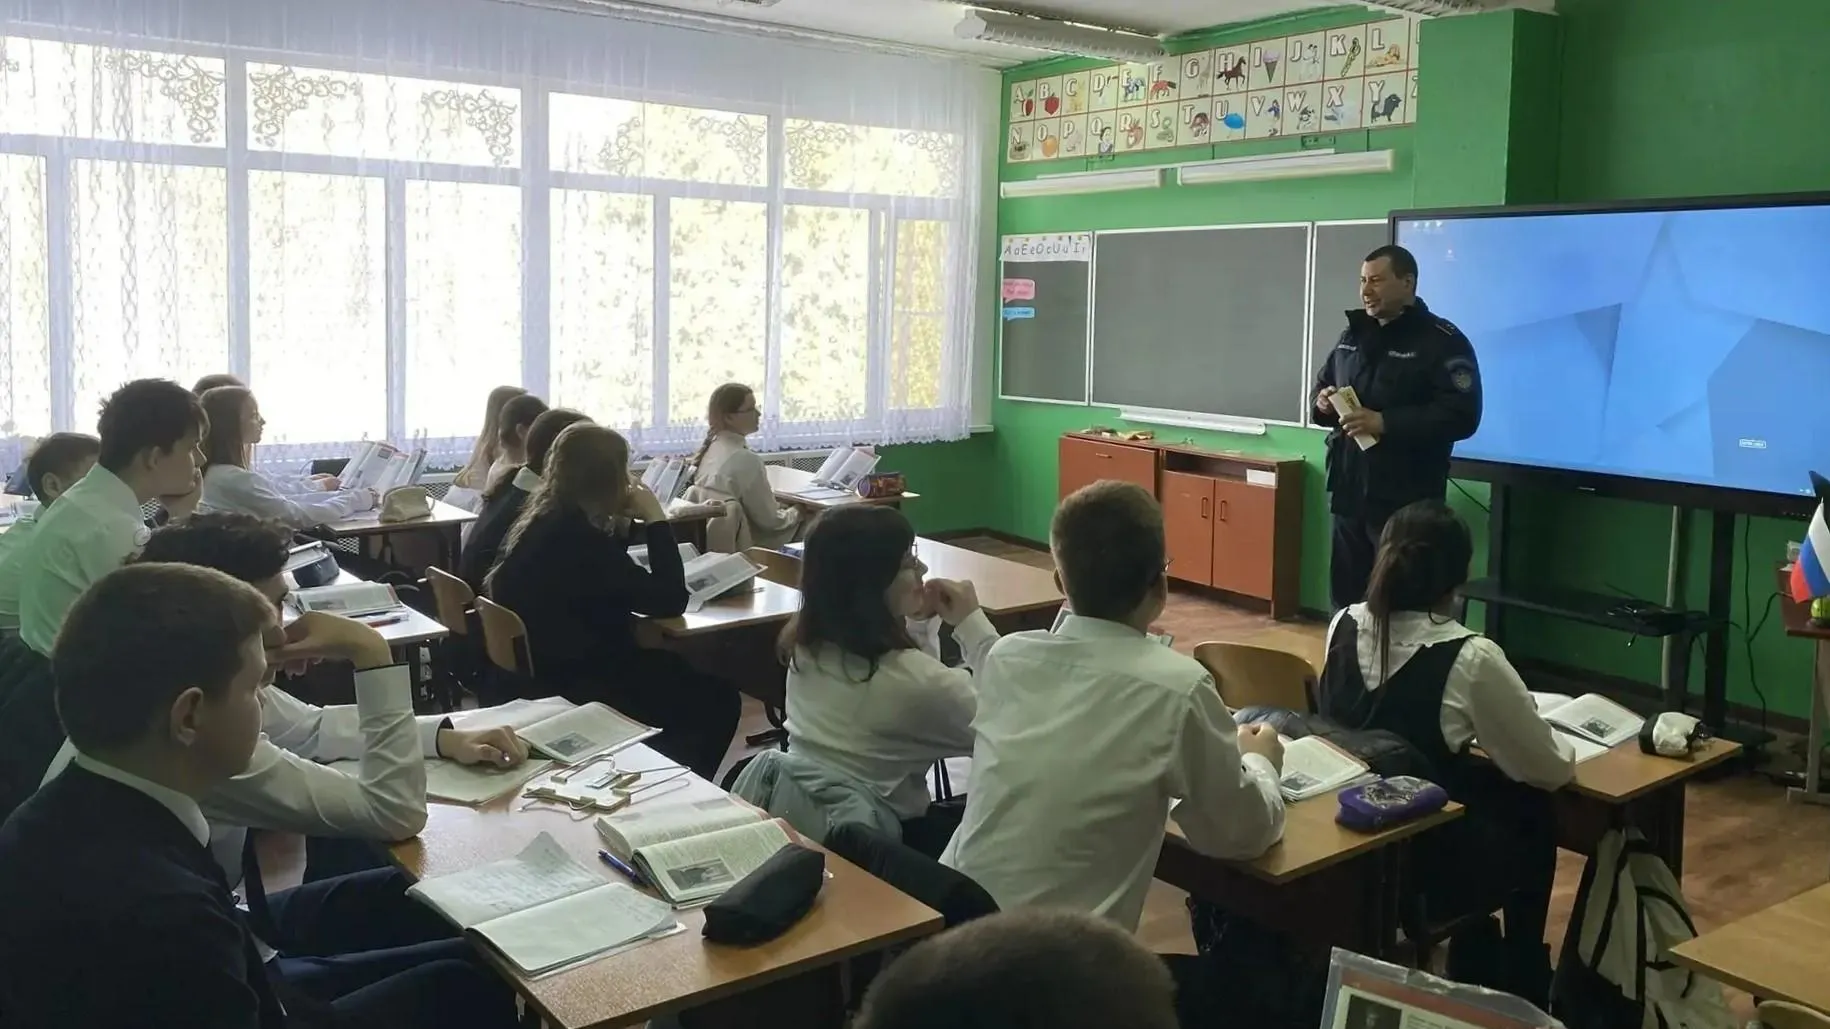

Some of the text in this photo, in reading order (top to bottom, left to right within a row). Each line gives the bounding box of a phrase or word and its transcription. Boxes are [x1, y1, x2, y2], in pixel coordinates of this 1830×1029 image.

[1330, 34, 1347, 57] K
[1371, 28, 1385, 51] L
[1254, 47, 1262, 68] I
[1290, 40, 1303, 62] J
[1152, 64, 1163, 83] F
[1185, 58, 1199, 79] G
[1040, 82, 1050, 101] B
[1065, 78, 1077, 97] C
[1093, 74, 1105, 93] D
[1368, 80, 1385, 104] Y
[1251, 96, 1265, 116] V
[1286, 90, 1307, 112] W
[1326, 85, 1344, 108] X
[1150, 108, 1161, 129] S
[1182, 104, 1195, 125] T
[1215, 100, 1229, 121] U
[1011, 126, 1023, 145] N
[1037, 124, 1048, 142] O
[1062, 120, 1075, 139] P
